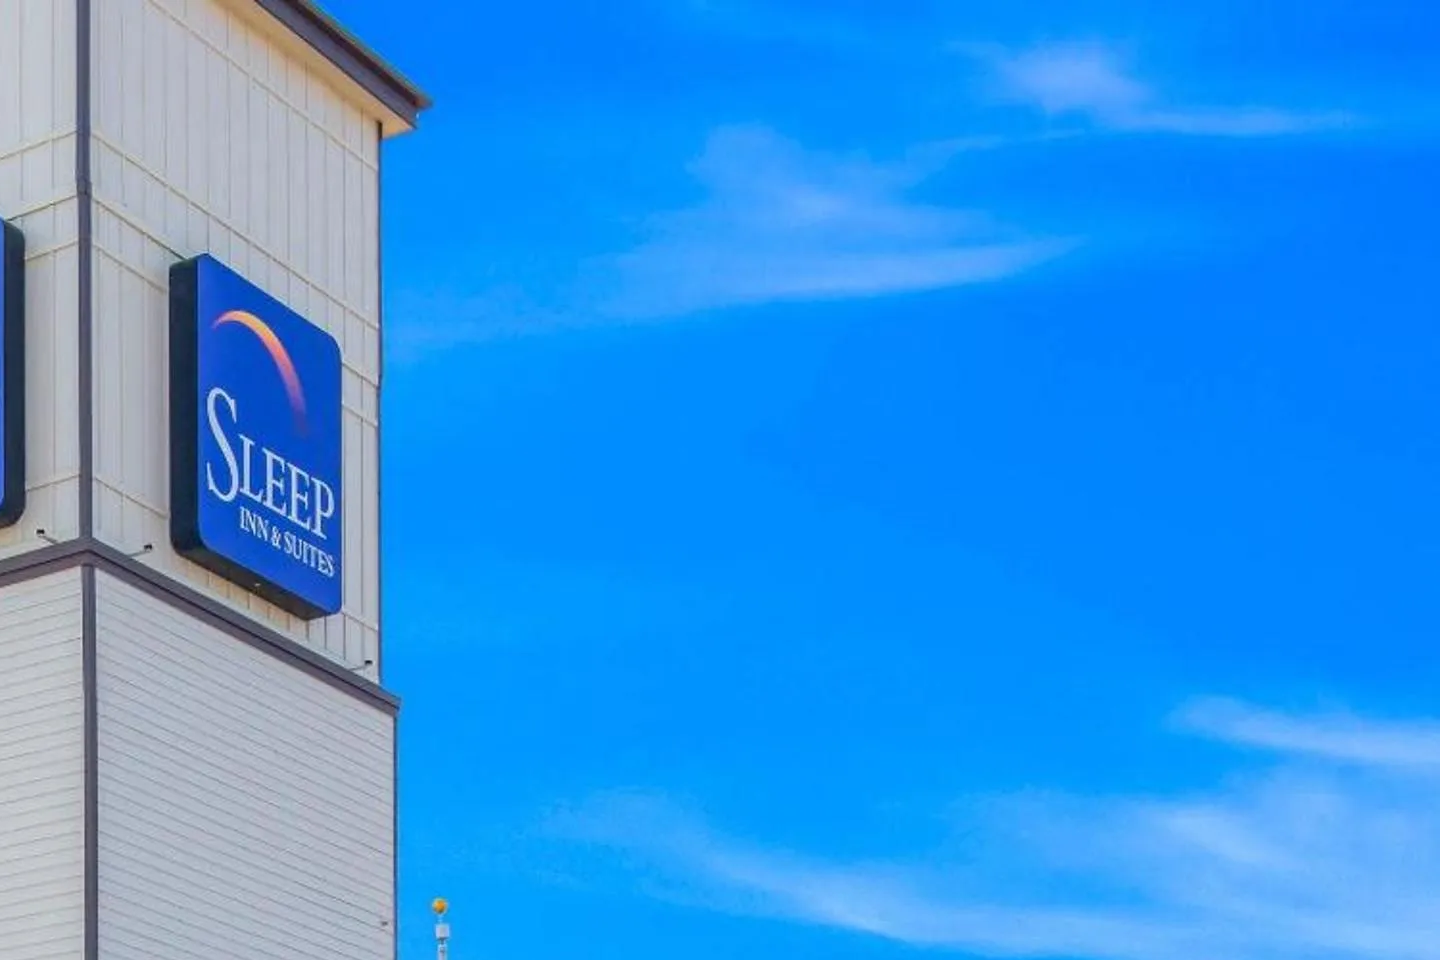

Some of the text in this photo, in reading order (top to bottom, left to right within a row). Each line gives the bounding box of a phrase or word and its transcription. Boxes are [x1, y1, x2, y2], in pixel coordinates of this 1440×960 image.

[207, 387, 335, 540] SLEEP
[240, 505, 335, 578] INN & SUITES
